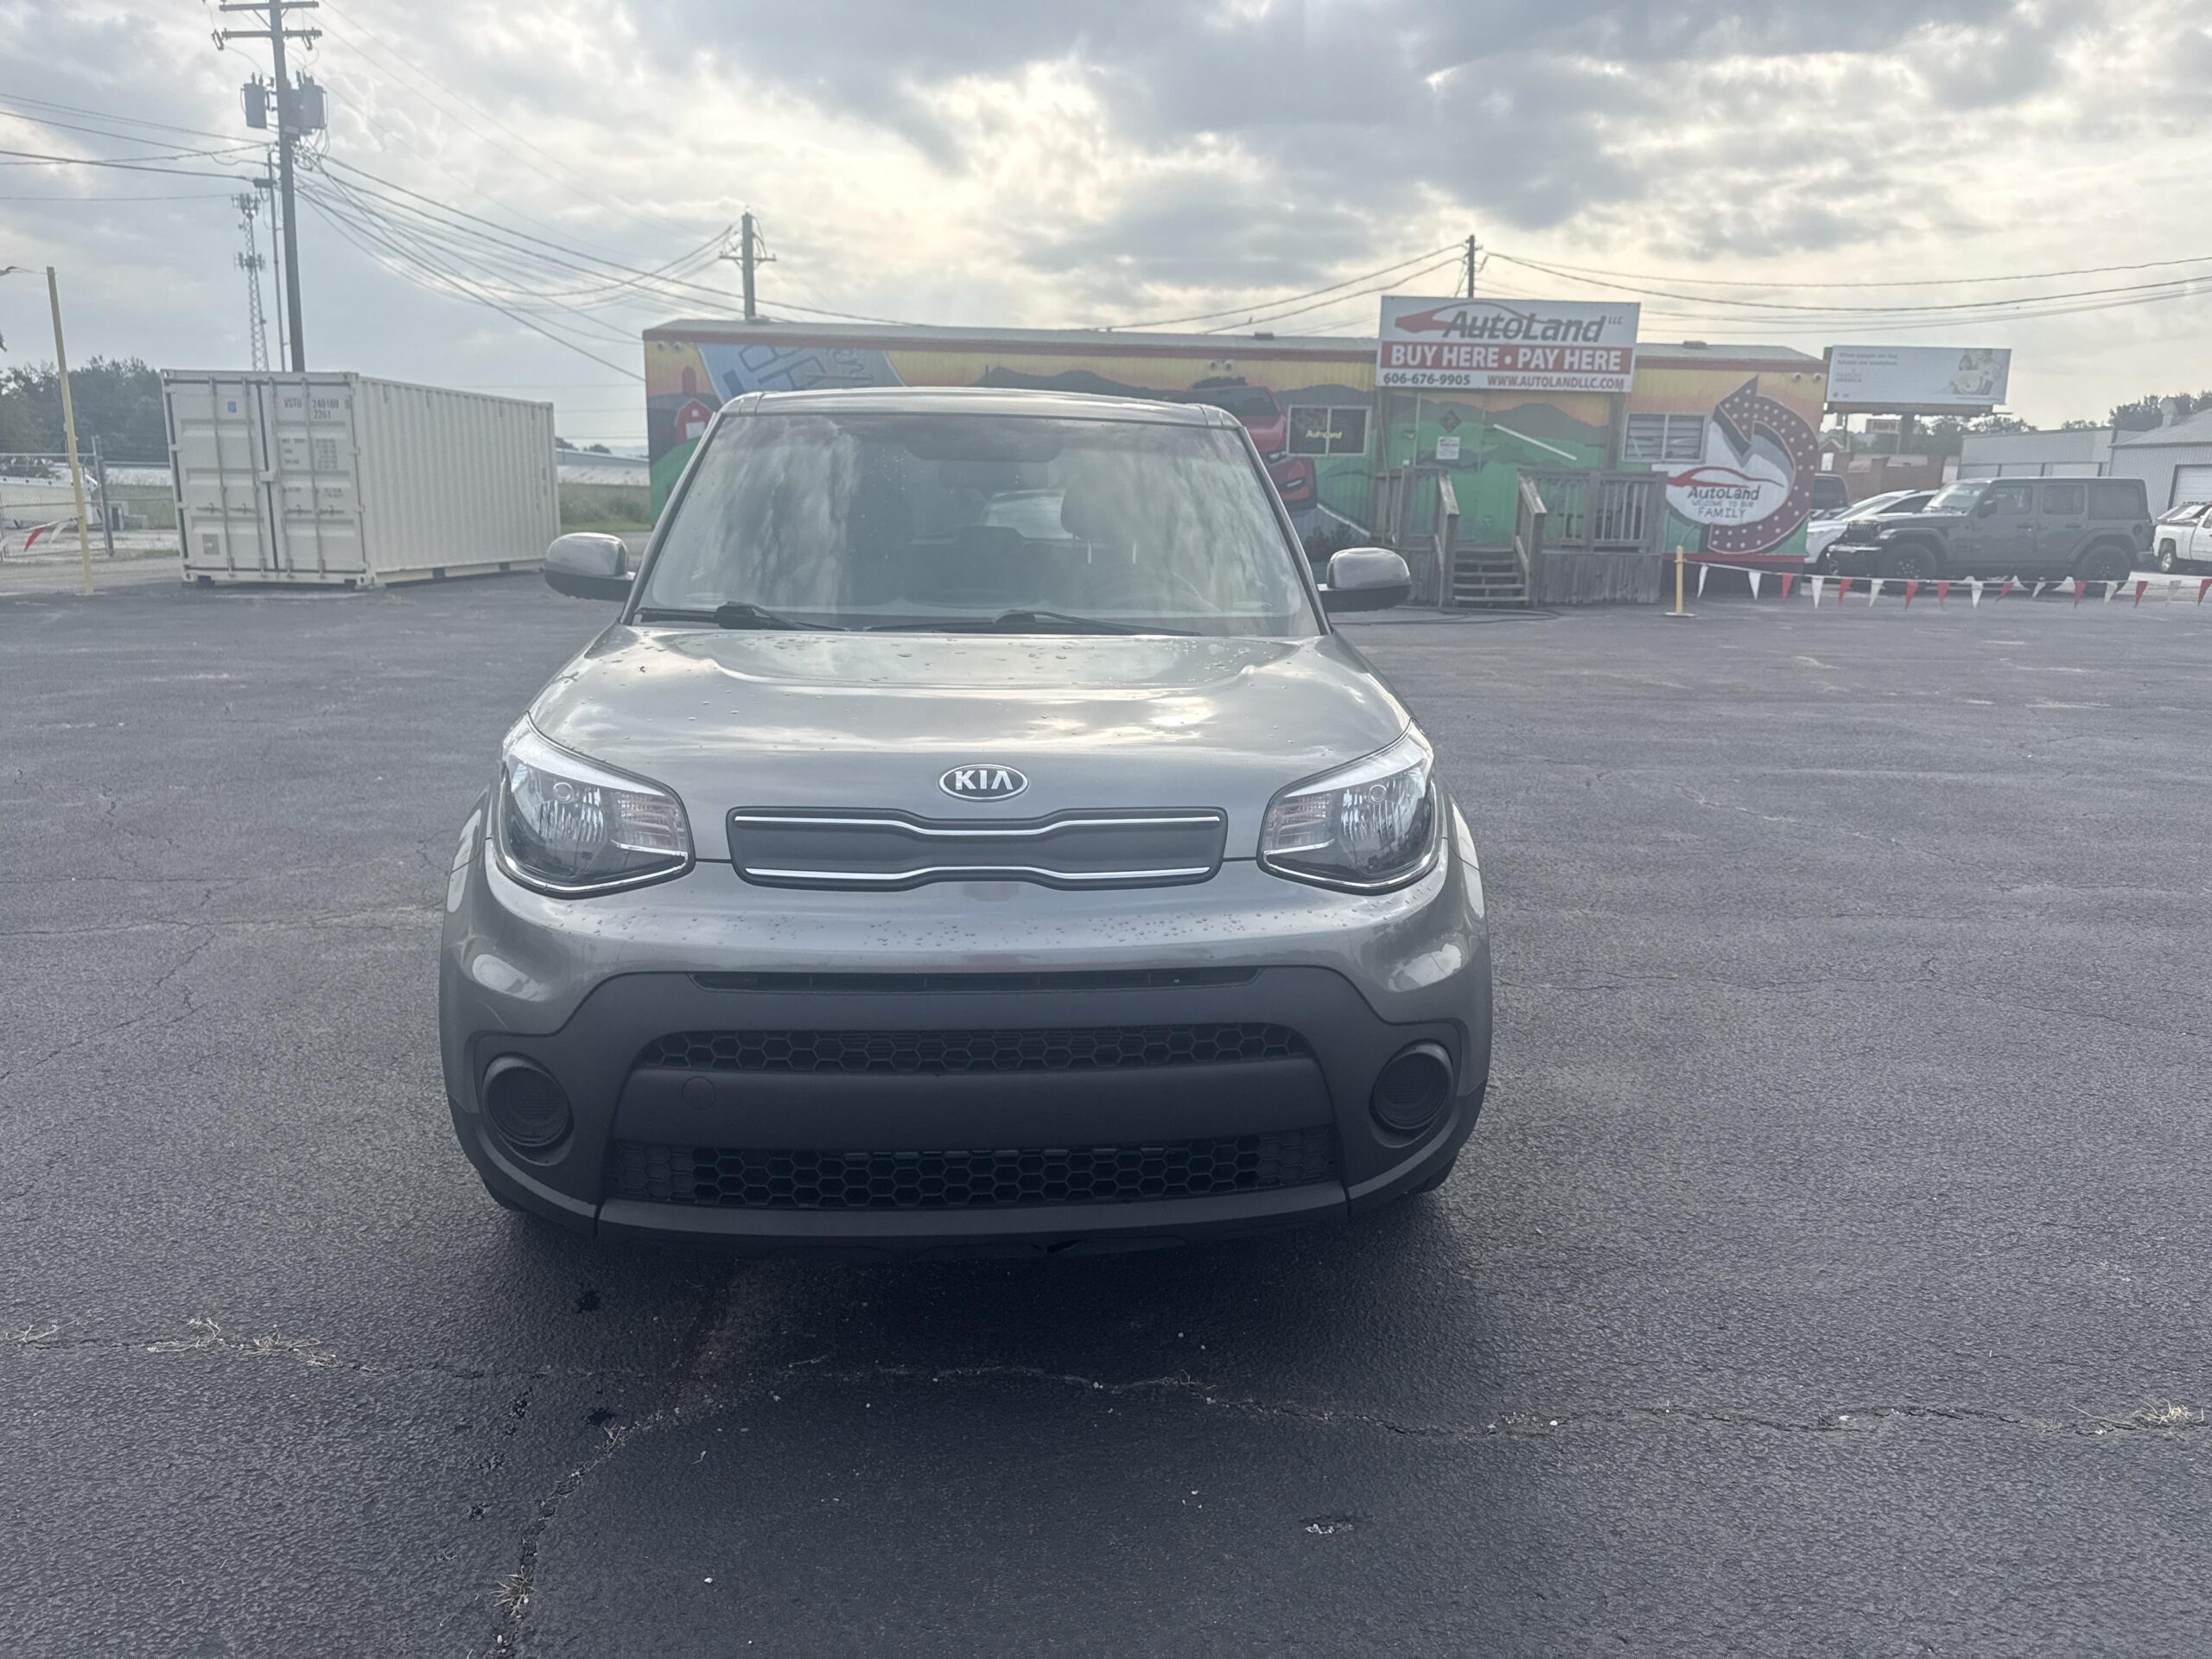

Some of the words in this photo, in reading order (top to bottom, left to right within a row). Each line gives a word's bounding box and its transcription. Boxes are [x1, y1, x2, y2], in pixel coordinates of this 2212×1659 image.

[1442, 310, 1607, 343] AutoLand
[1608, 315, 1624, 326] LLC
[1390, 345, 1438, 366] BUY
[1441, 346, 1499, 368] HERE
[1516, 347, 1560, 370] PAY
[1563, 349, 1622, 372] HERE
[1383, 372, 1471, 385] 606-676-9905
[1487, 374, 1624, 390] WWW.AUTOLANDLLC.COM
[1687, 484, 1762, 500] AutoLand
[1697, 506, 1746, 518] FAMILY
[954, 769, 1014, 791] KIA
